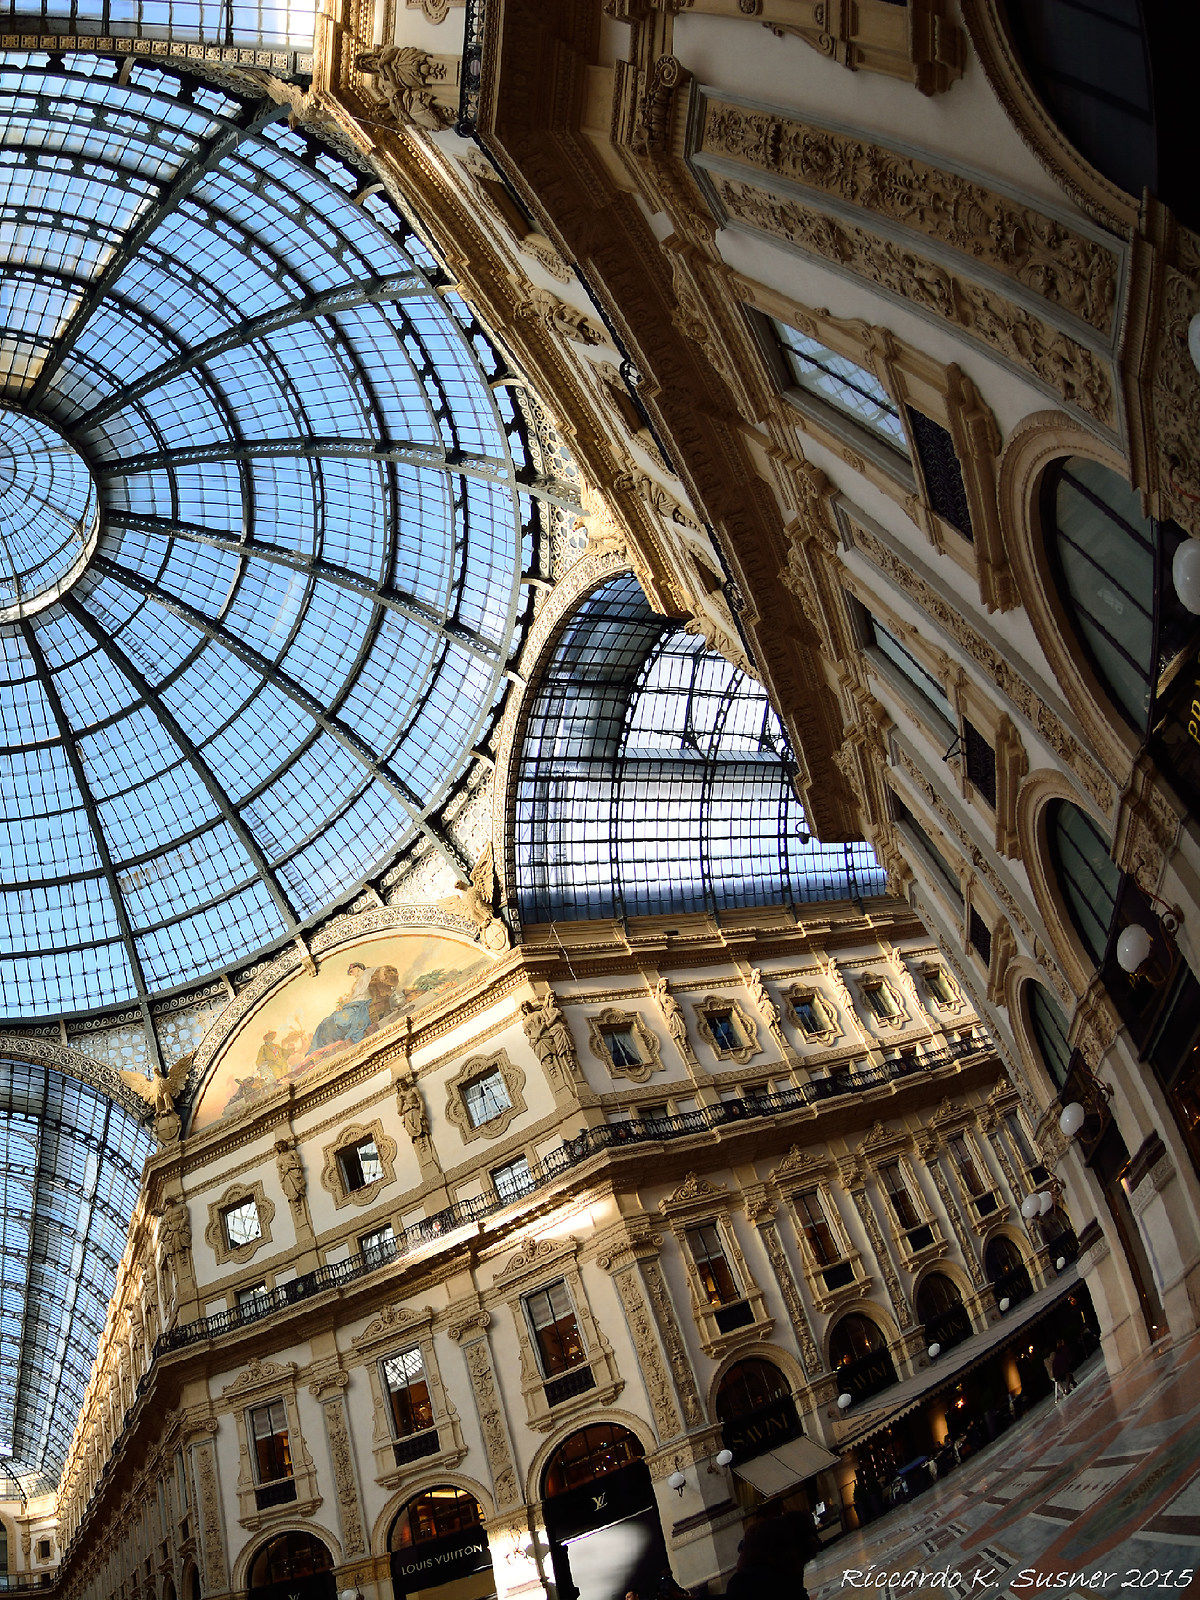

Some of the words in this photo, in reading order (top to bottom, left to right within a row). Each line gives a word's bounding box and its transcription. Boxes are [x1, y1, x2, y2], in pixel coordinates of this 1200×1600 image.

[732, 1411, 789, 1448] SAVINI
[401, 1558, 433, 1575] LOUIS
[434, 1544, 483, 1565] VUITTON
